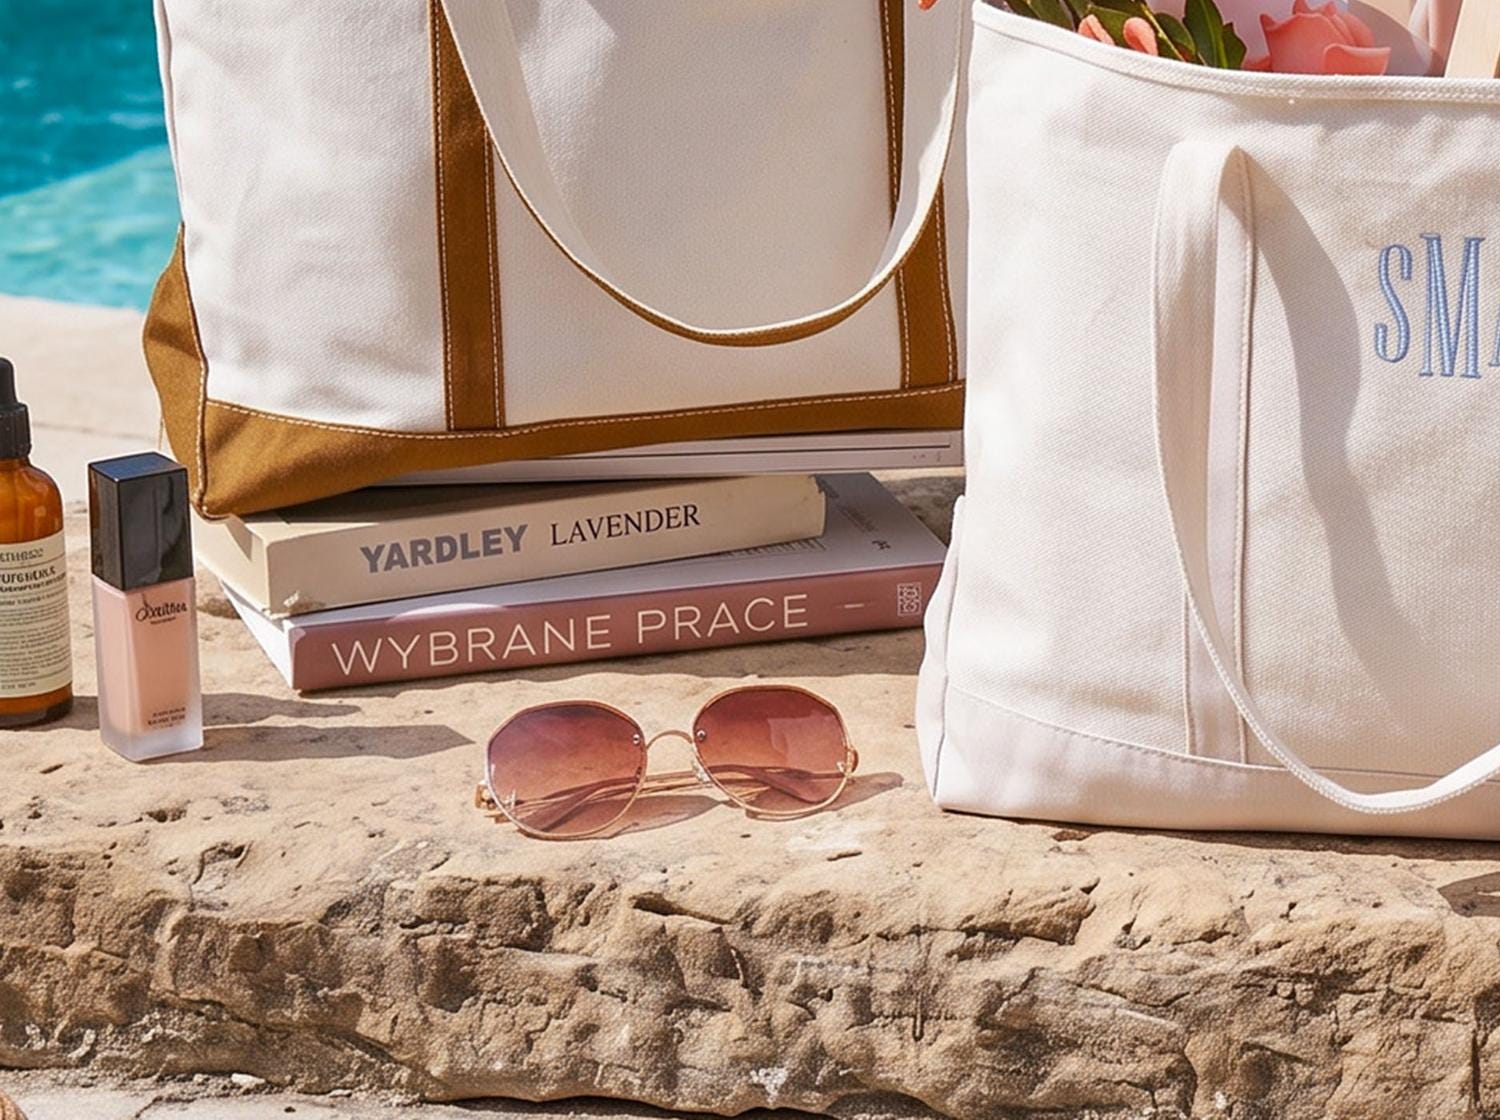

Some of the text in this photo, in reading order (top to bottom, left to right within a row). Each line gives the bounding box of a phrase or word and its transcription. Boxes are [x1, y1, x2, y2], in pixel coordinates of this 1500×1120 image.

[360, 504, 700, 573] YARDLEY LAVENDER
[331, 594, 809, 676] WYBRANE PRACE
